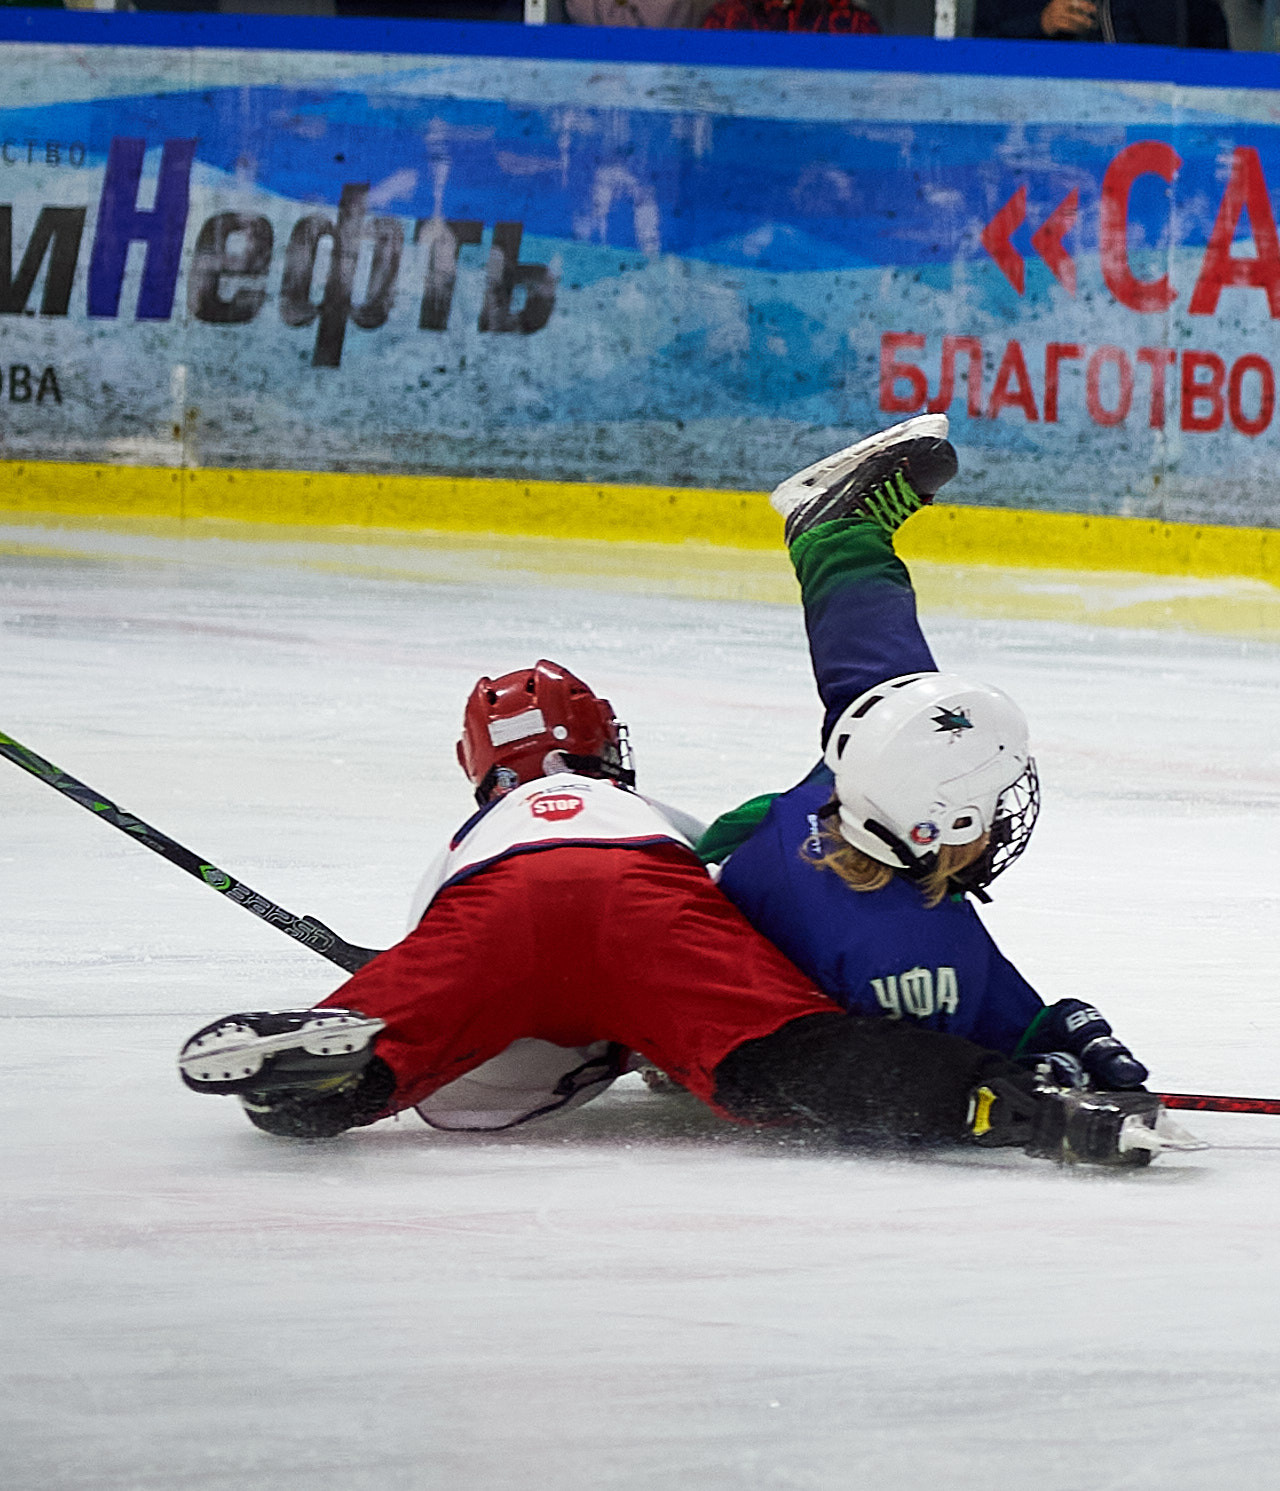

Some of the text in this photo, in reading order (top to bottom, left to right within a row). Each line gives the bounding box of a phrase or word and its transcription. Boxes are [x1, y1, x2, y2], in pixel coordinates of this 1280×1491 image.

[0, 363, 63, 406] ВА
[533, 798, 581, 815] STOP
[870, 966, 960, 1020] УФА
